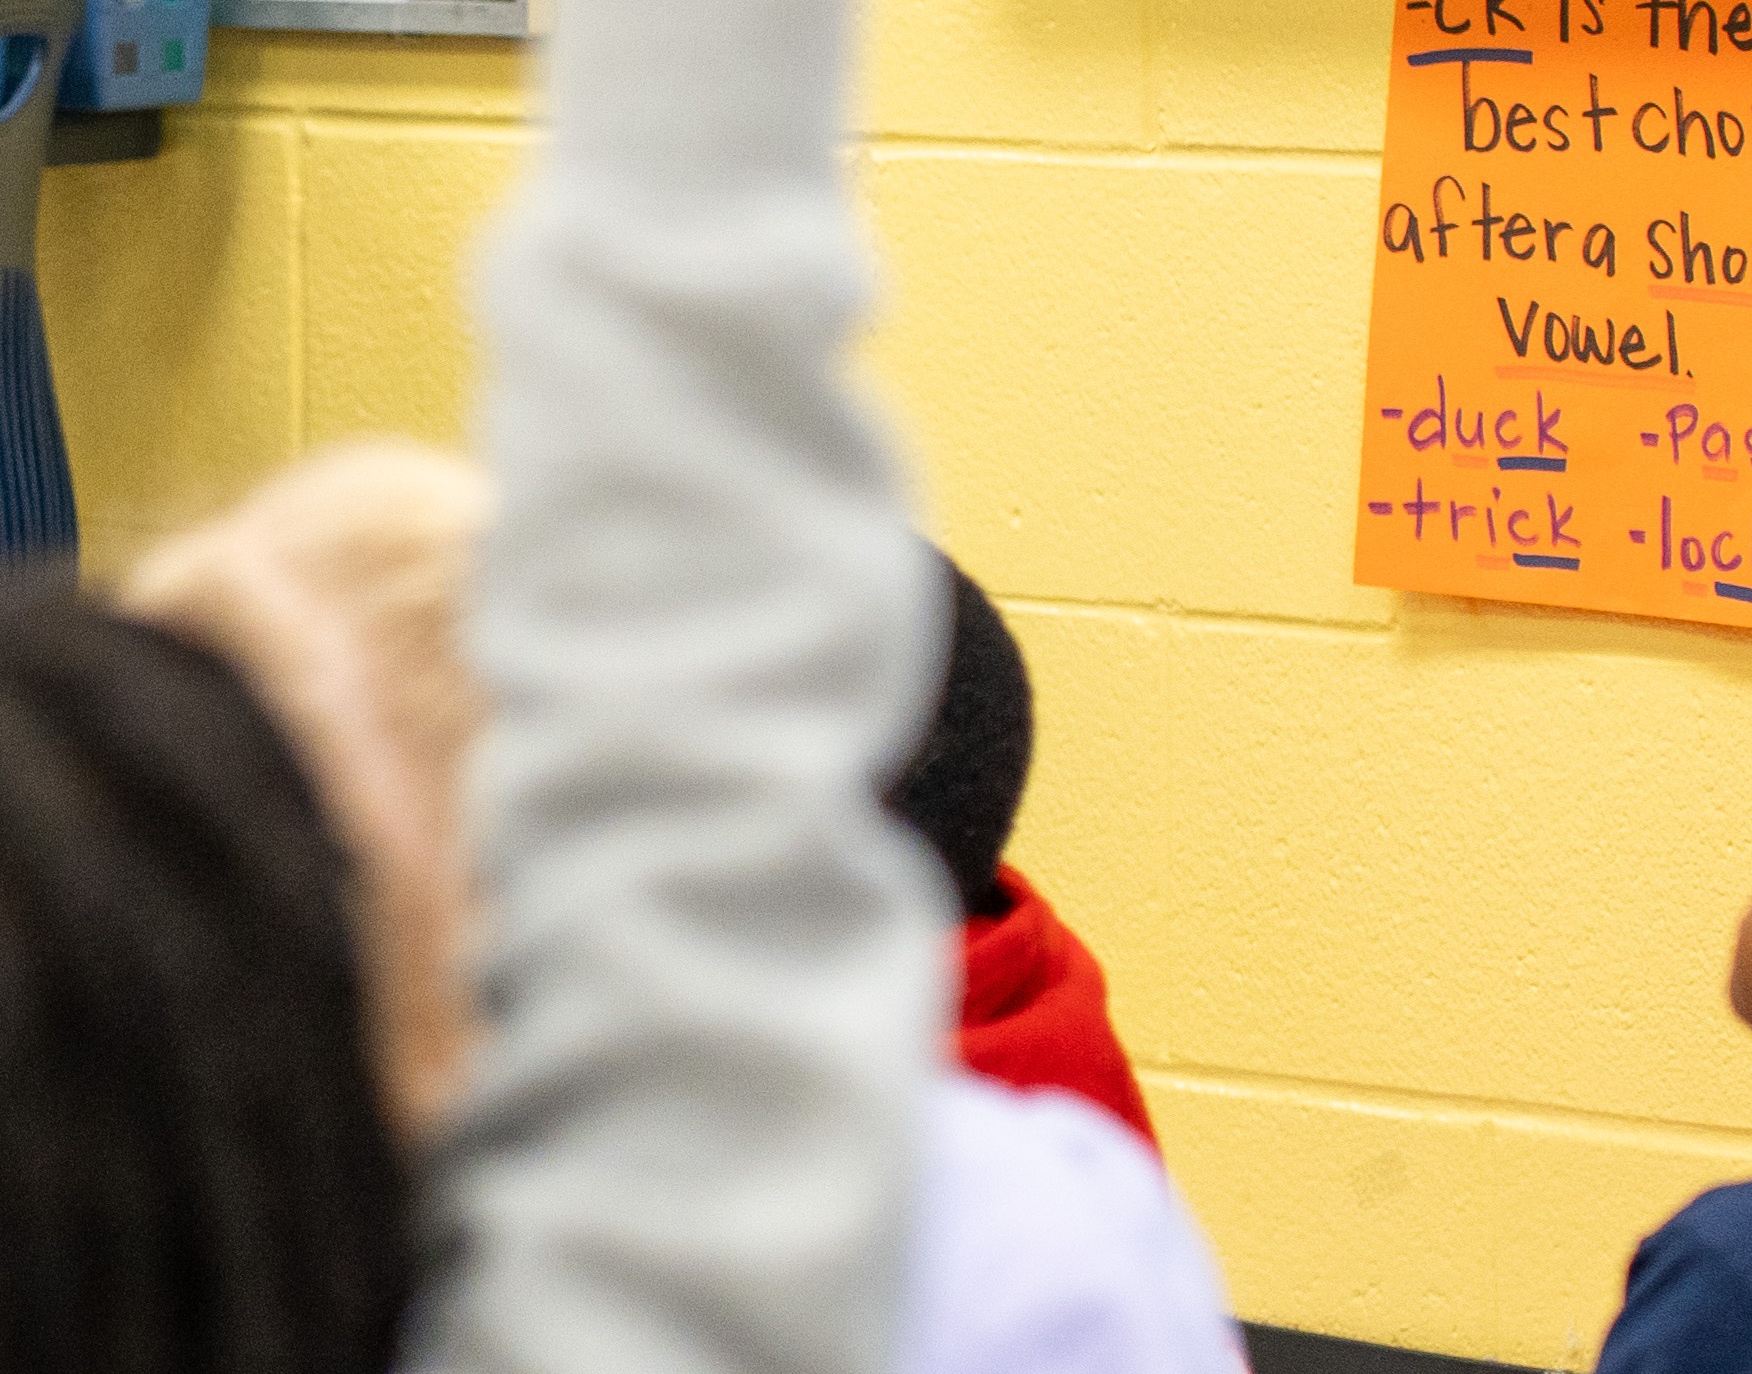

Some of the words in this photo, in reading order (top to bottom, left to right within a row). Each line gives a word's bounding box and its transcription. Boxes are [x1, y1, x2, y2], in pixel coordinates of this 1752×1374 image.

[1462, 59, 1618, 152] best
[1382, 175, 1575, 264] after
[1583, 223, 1616, 278] a
[1380, 374, 1568, 455] -duck
[1368, 478, 1582, 549] -trick
